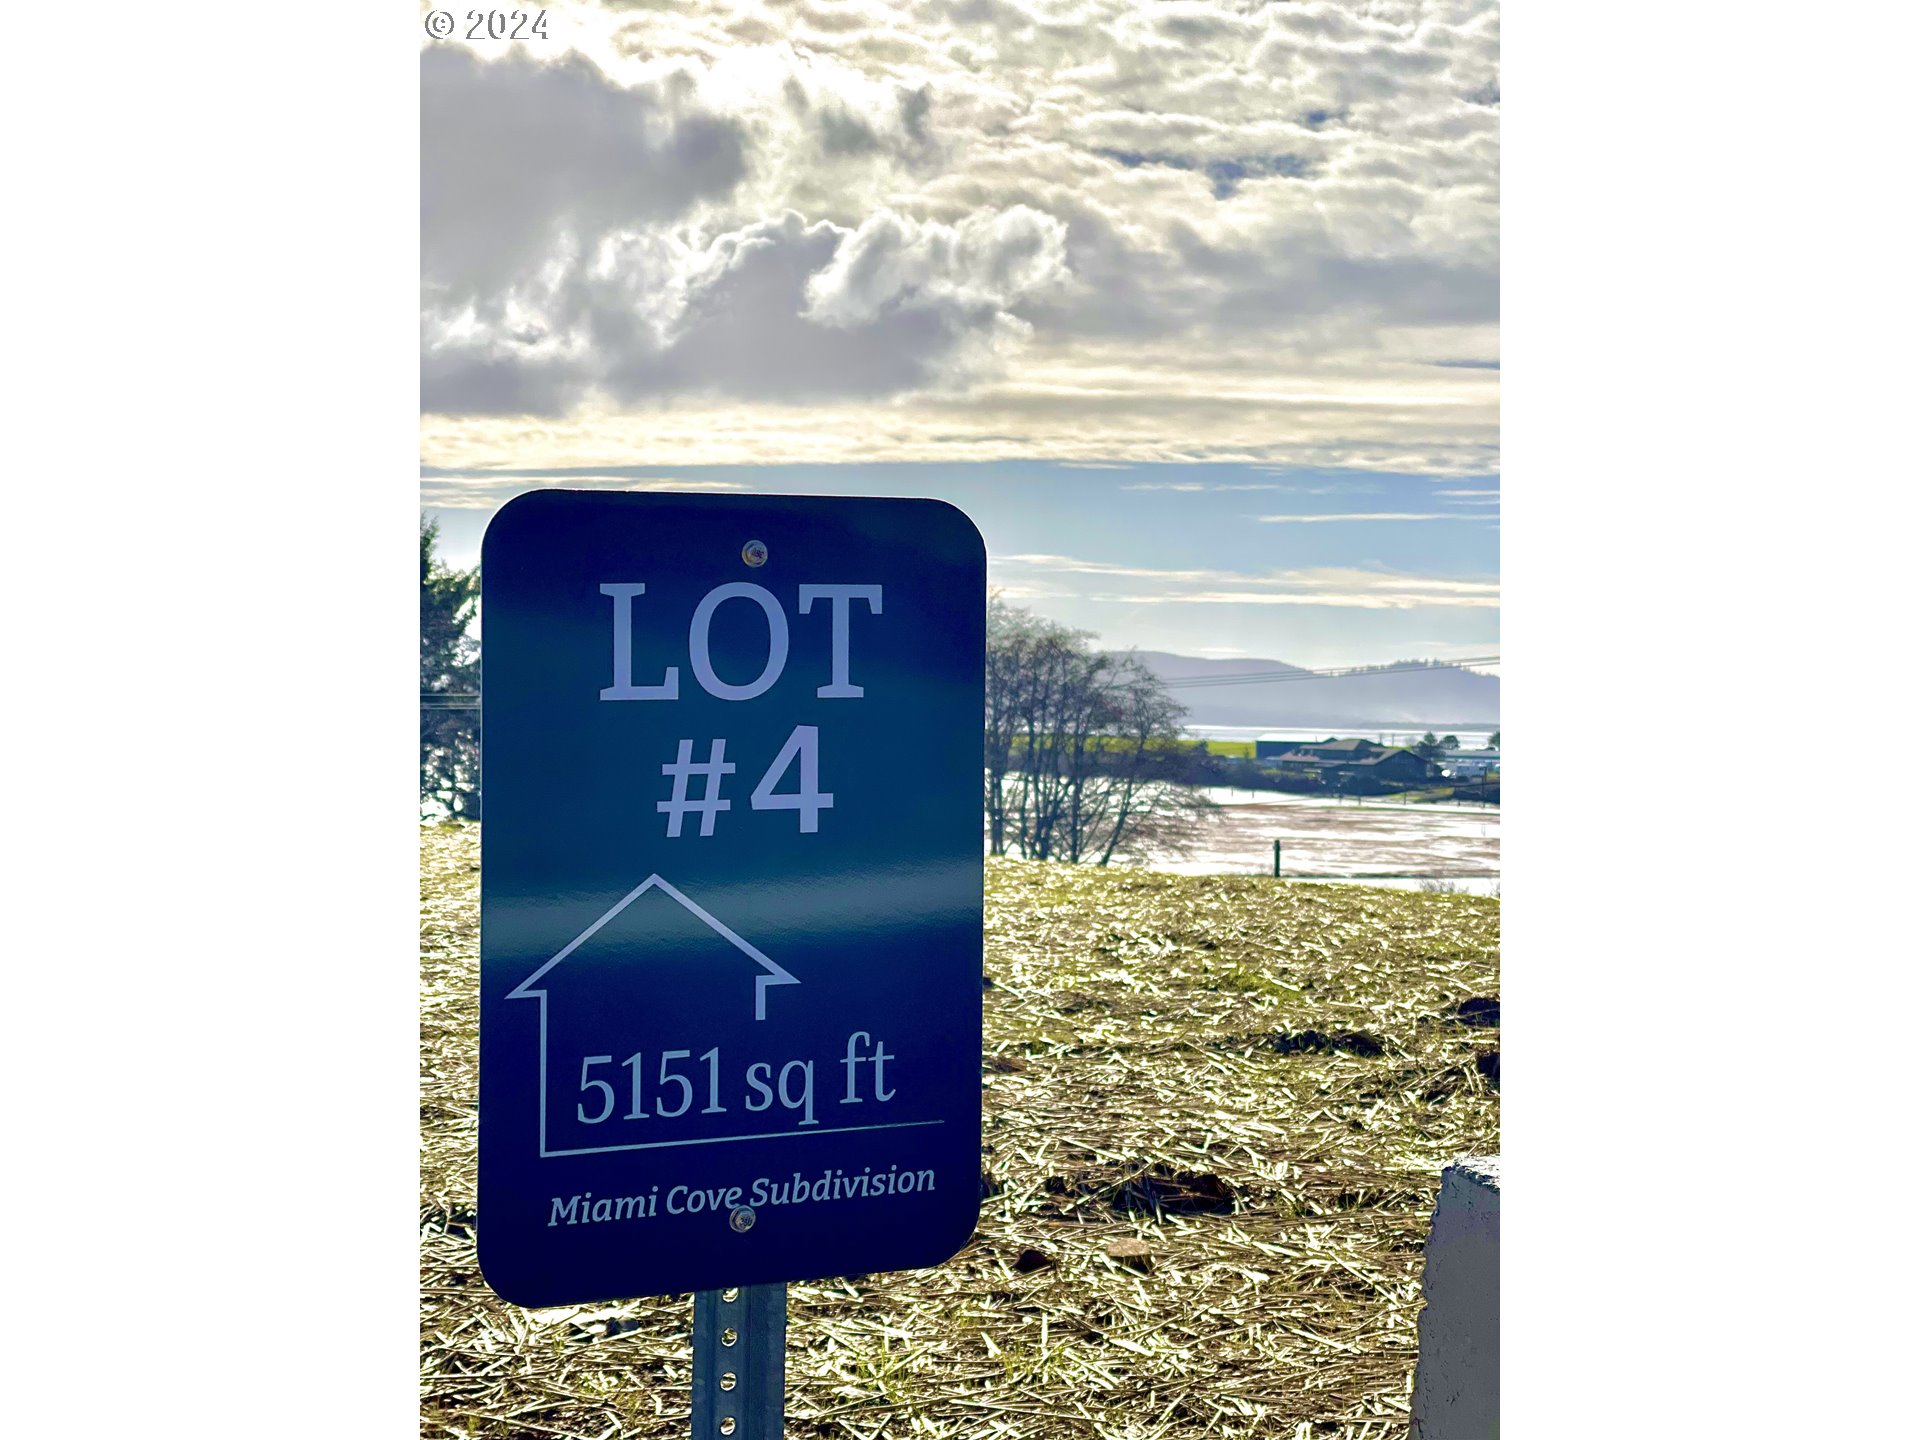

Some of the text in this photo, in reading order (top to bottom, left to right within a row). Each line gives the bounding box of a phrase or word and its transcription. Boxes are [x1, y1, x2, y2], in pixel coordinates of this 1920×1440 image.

[600, 581, 883, 701] LOT
[656, 725, 834, 838] #4
[576, 1031, 897, 1126] 5151 sq ft
[547, 1164, 936, 1227] Miami Cove Subdivision
